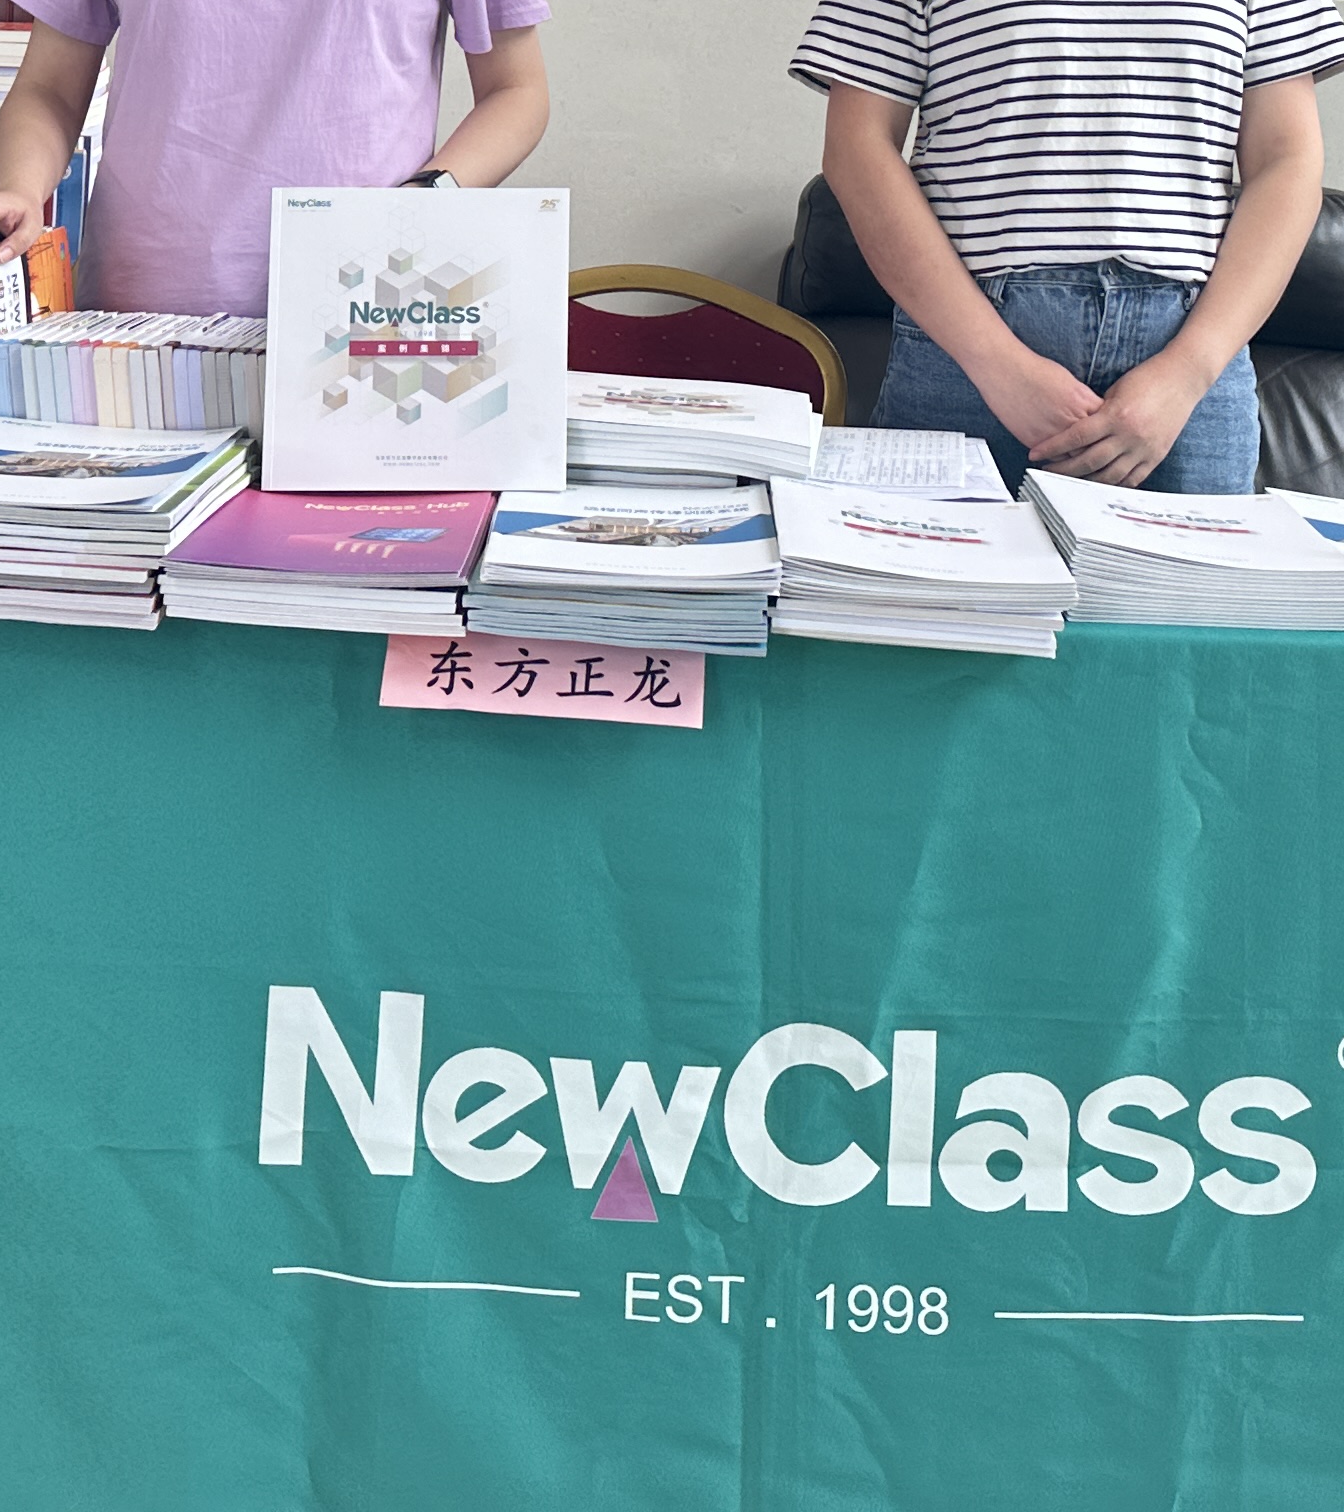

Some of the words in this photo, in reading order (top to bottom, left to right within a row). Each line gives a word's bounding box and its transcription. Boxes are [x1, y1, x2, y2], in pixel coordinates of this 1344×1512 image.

[349, 301, 481, 326] NewClass
[304, 502, 417, 512] NewClass
[425, 640, 682, 709] 东方正龙
[258, 984, 1318, 1218] NewClass
[813, 1283, 951, 1335] 1998
